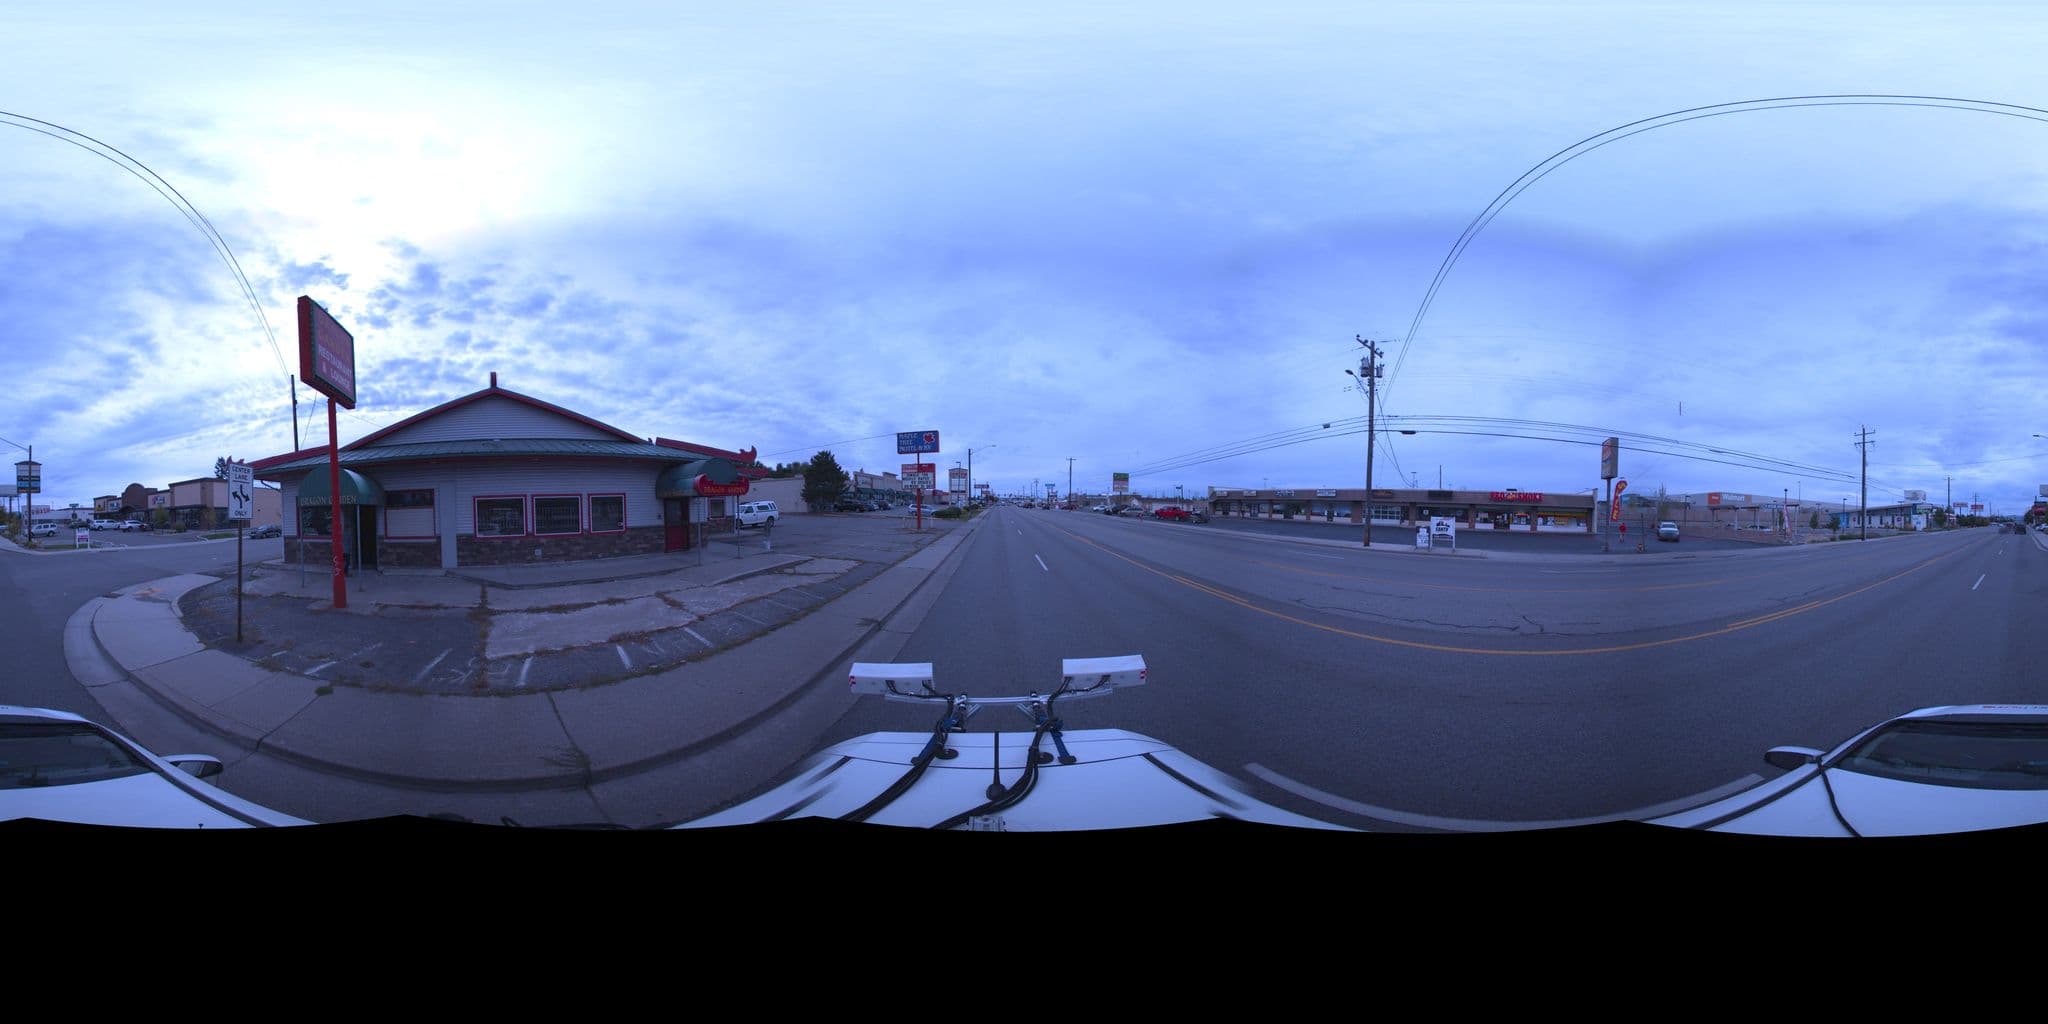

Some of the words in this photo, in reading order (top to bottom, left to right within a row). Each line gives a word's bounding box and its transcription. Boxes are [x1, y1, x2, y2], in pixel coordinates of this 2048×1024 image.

[301, 496, 326, 506] DRAGON
[328, 495, 357, 505] GDEN
[1722, 493, 1745, 501] Walmart
